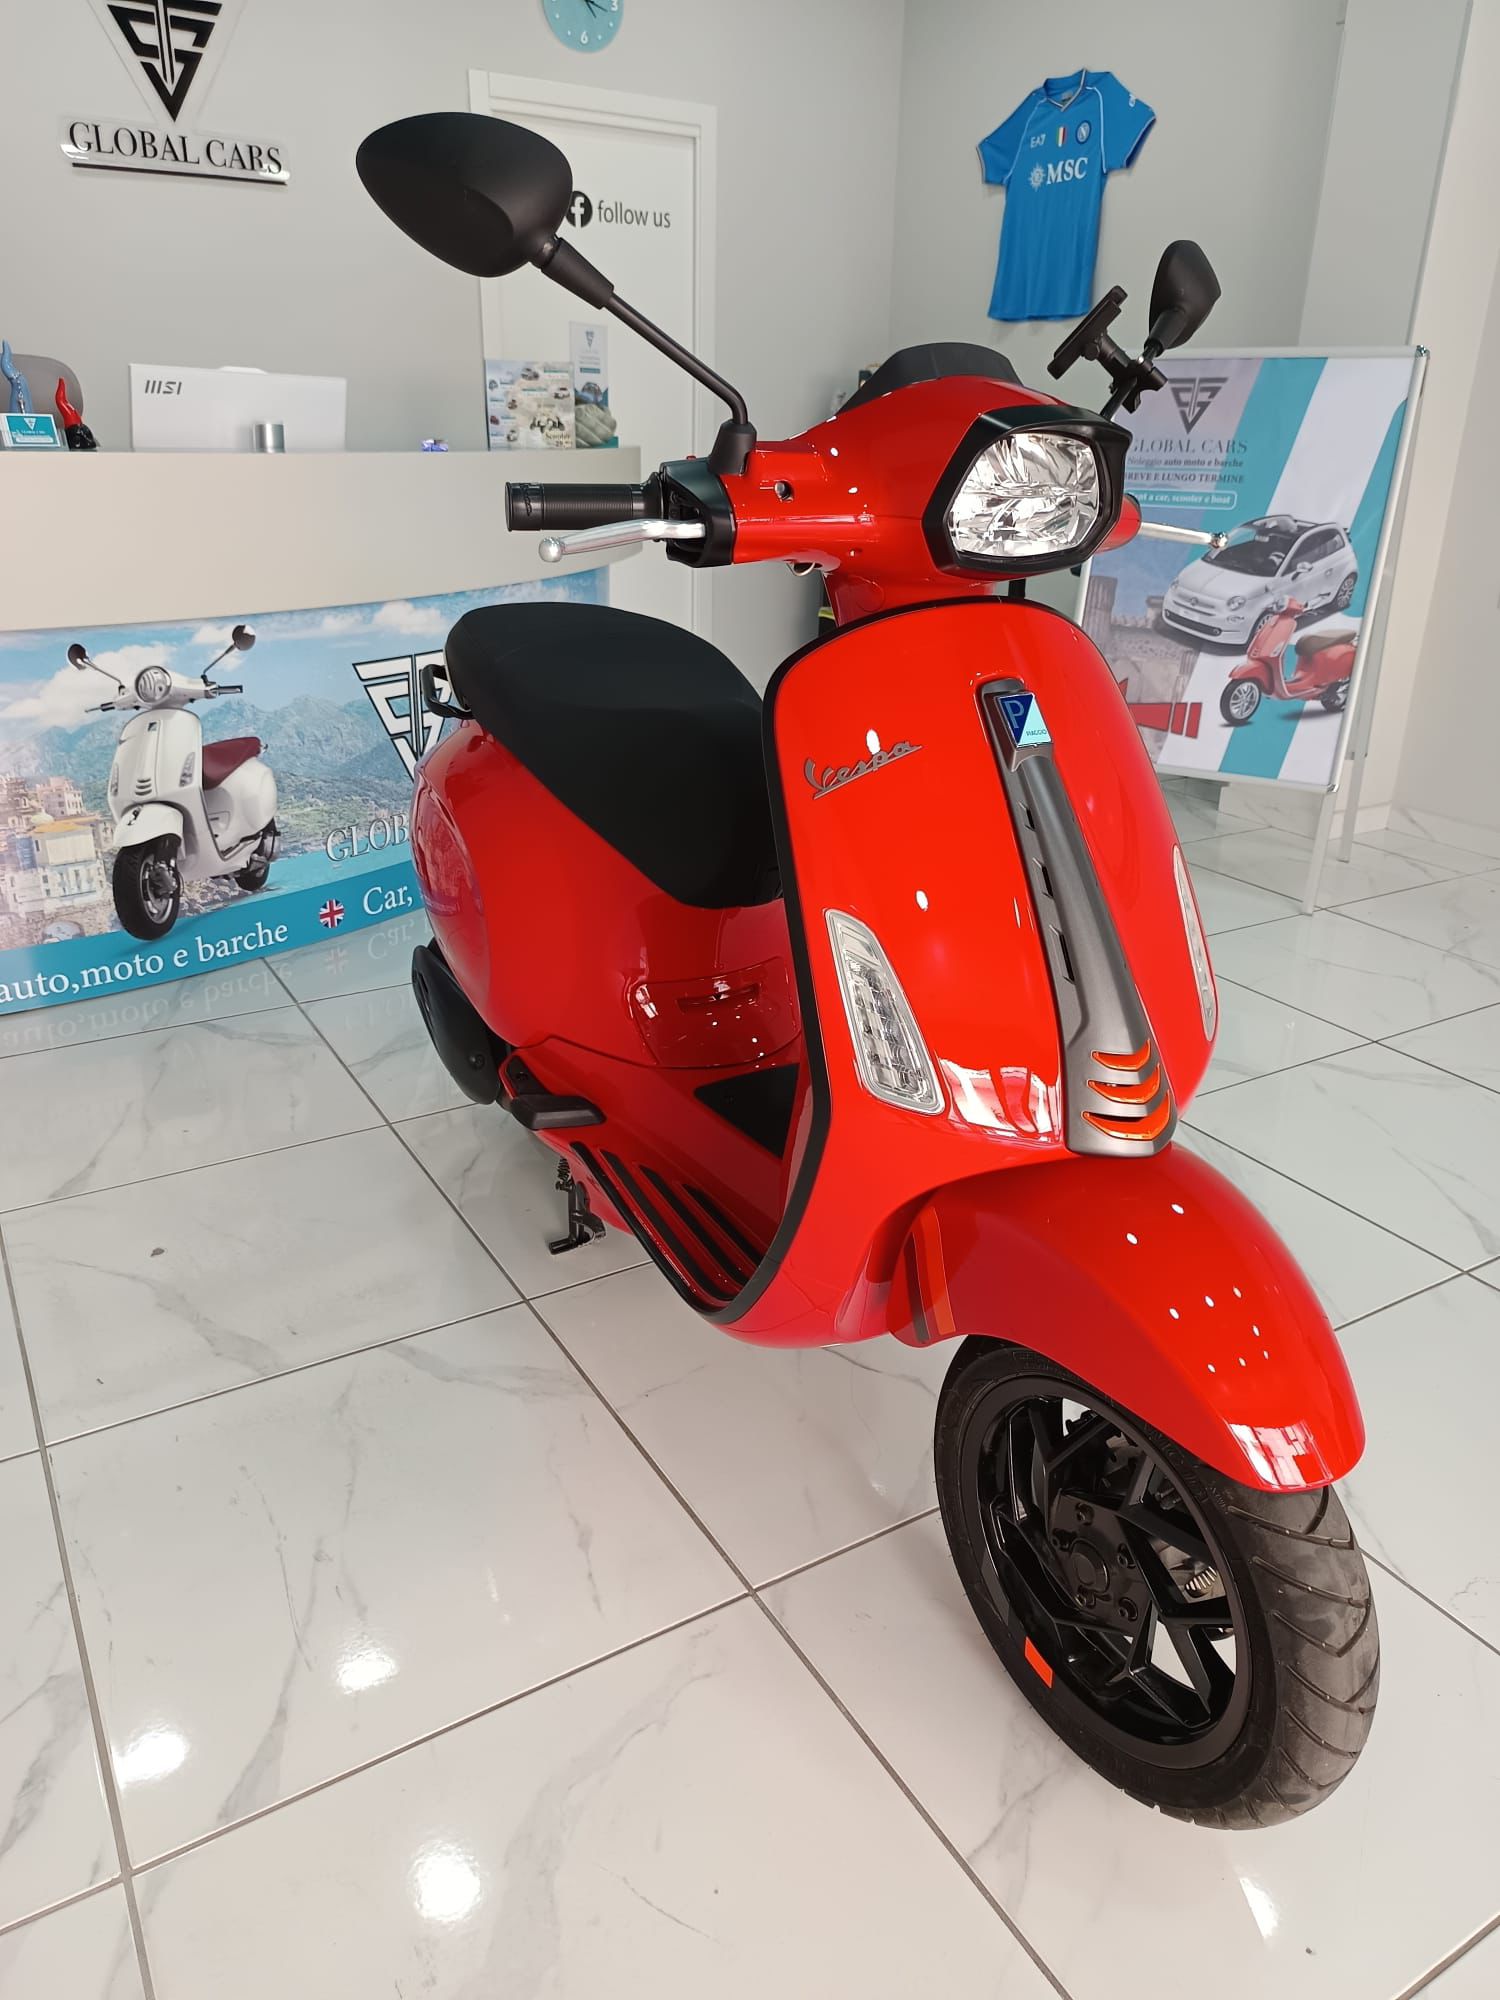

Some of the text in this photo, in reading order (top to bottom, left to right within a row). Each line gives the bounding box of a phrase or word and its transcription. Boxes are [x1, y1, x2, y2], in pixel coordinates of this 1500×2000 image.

[580, 31, 588, 44] 6
[69, 121, 282, 174] GLOBAL CARS
[1030, 134, 1046, 148] EA7
[1046, 157, 1088, 185] MSC
[597, 199, 649, 227] follow
[653, 210, 671, 229] us
[1202, 439, 1248, 454] CARS
[1153, 472, 1159, 481] E
[1161, 472, 1196, 482] LUNGO
[1199, 473, 1245, 484] TERMINE
[1164, 458, 1181, 466] auto
[1184, 459, 1206, 467] moto
[1214, 459, 1244, 468] barche
[1003, 699, 1024, 729] P
[804, 740, 922, 800] Vespa
[326, 813, 410, 862] GLOB
[363, 885, 413, 916] Car,
[173, 947, 189, 967] e
[195, 922, 289, 963] barche
